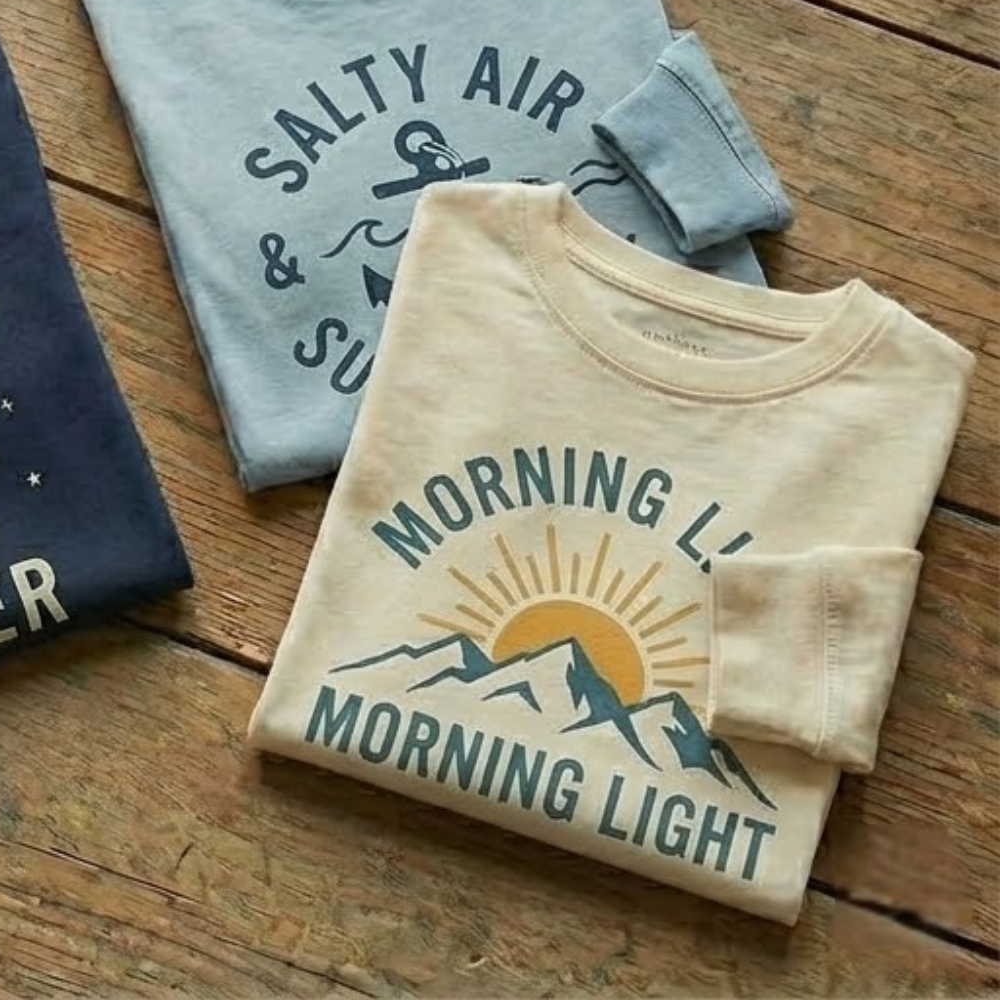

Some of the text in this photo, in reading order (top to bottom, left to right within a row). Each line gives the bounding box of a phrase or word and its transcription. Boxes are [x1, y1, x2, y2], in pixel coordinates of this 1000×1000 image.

[243, 43, 587, 194] SALTY AIR
[259, 231, 306, 290] &
[370, 445, 674, 570] MORNING
[302, 684, 778, 883] MORNING LIGHT
